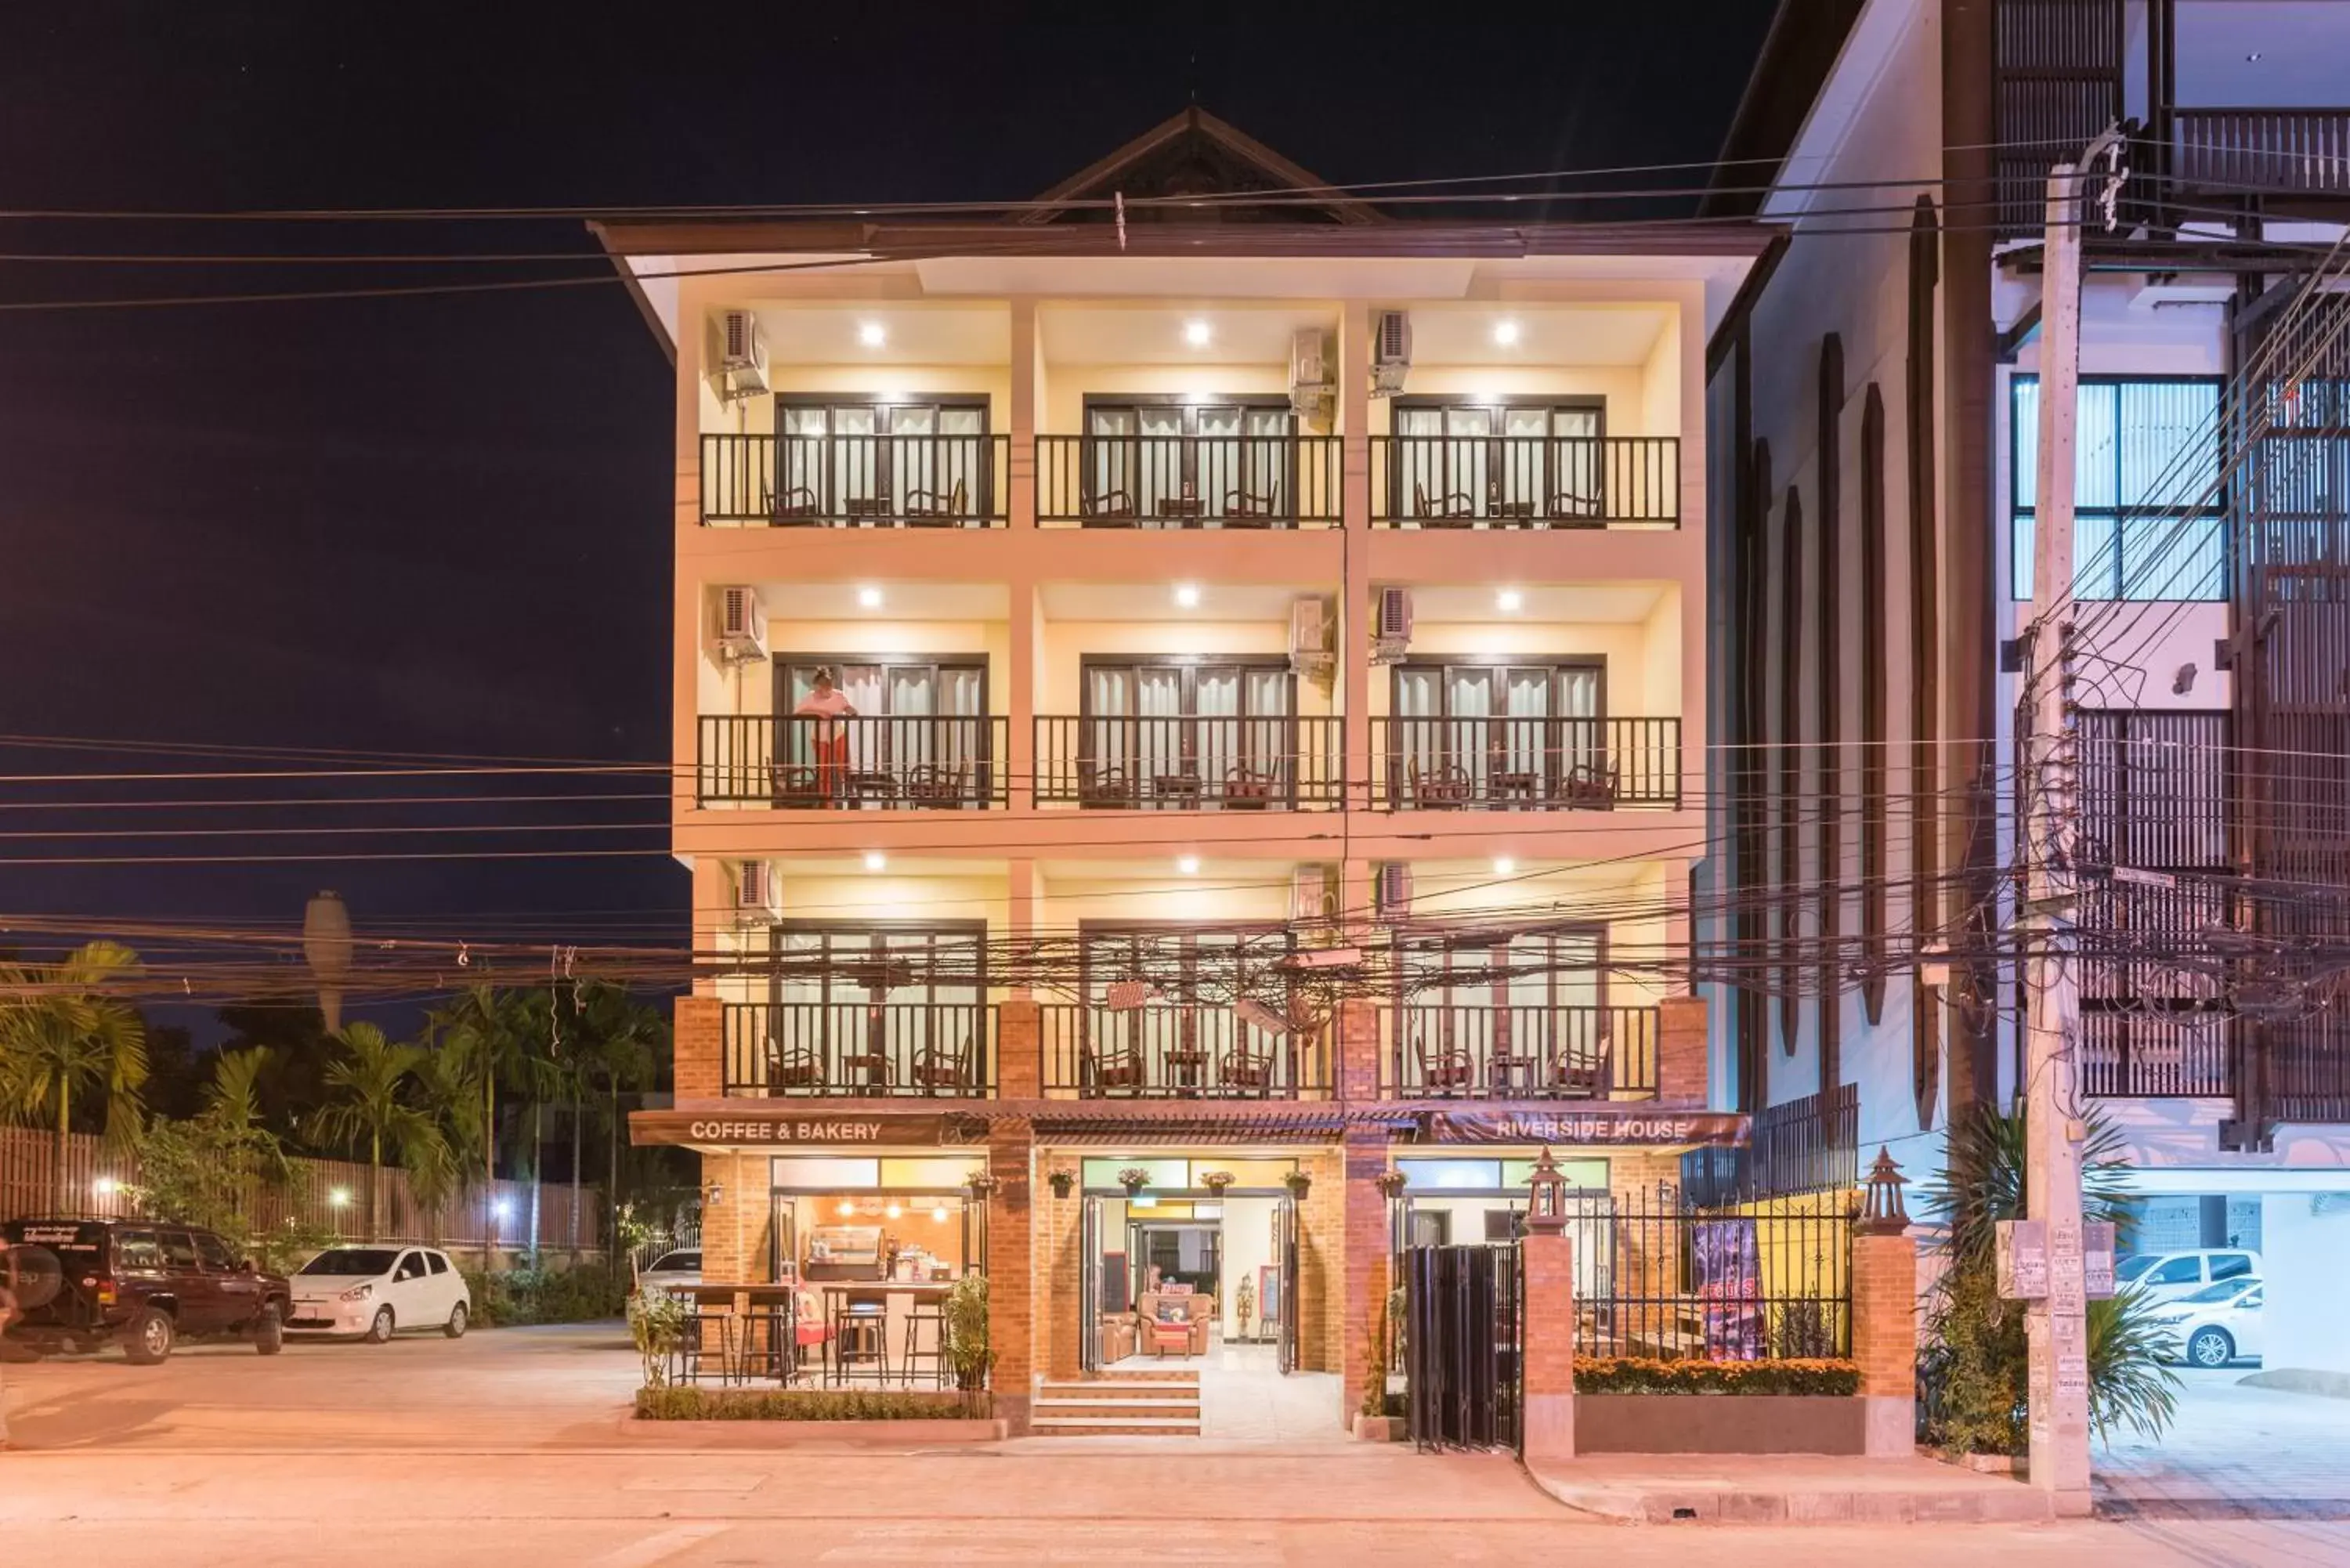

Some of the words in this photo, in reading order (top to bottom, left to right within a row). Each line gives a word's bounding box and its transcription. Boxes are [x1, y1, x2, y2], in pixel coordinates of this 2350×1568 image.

[690, 1122, 772, 1139] COFFEE
[777, 1122, 790, 1139] &
[797, 1122, 882, 1139] BAKERY
[1497, 1120, 1608, 1137] RIVERSIDE
[1614, 1120, 1687, 1138] HOUSE
